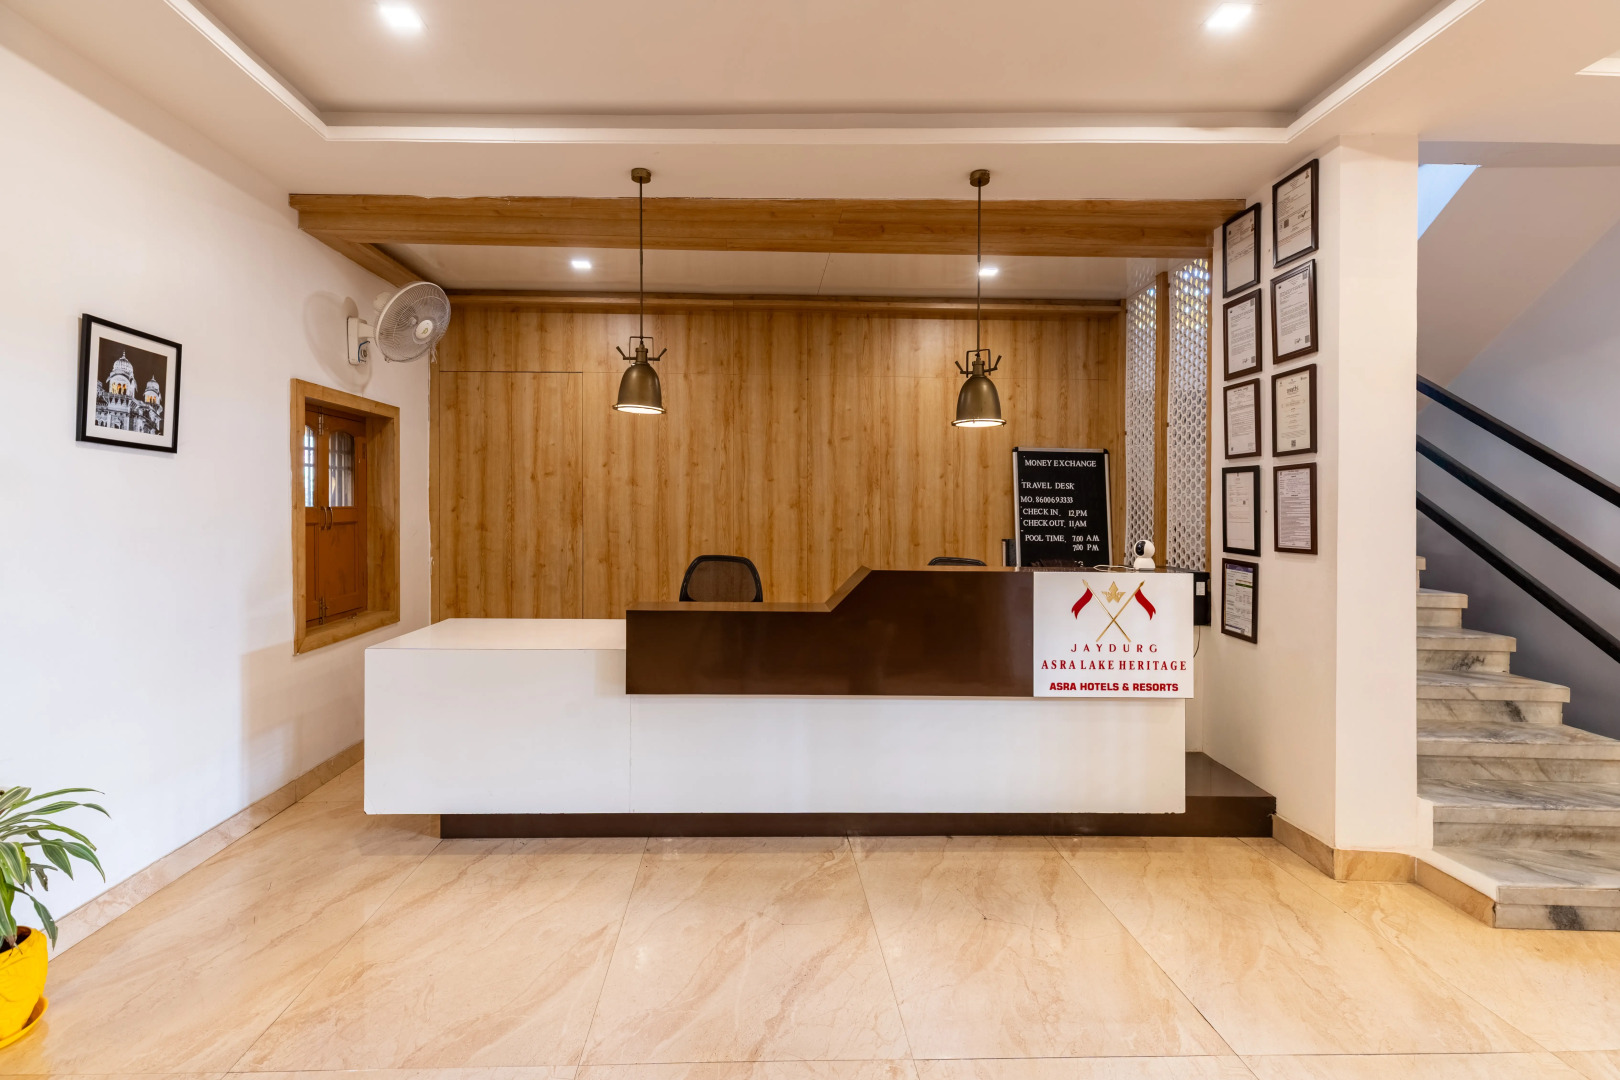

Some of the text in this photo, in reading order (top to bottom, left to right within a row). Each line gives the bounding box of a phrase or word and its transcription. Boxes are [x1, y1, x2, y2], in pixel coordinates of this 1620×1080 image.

[1055, 482, 1075, 490] DESK
[1022, 508, 1049, 516] CHECK
[1070, 643, 1158, 653] JAYDURG
[1041, 660, 1187, 671] ASRA LAKE HERITAGE
[1049, 682, 1179, 692] ASRA HOTELS & RESORTS
